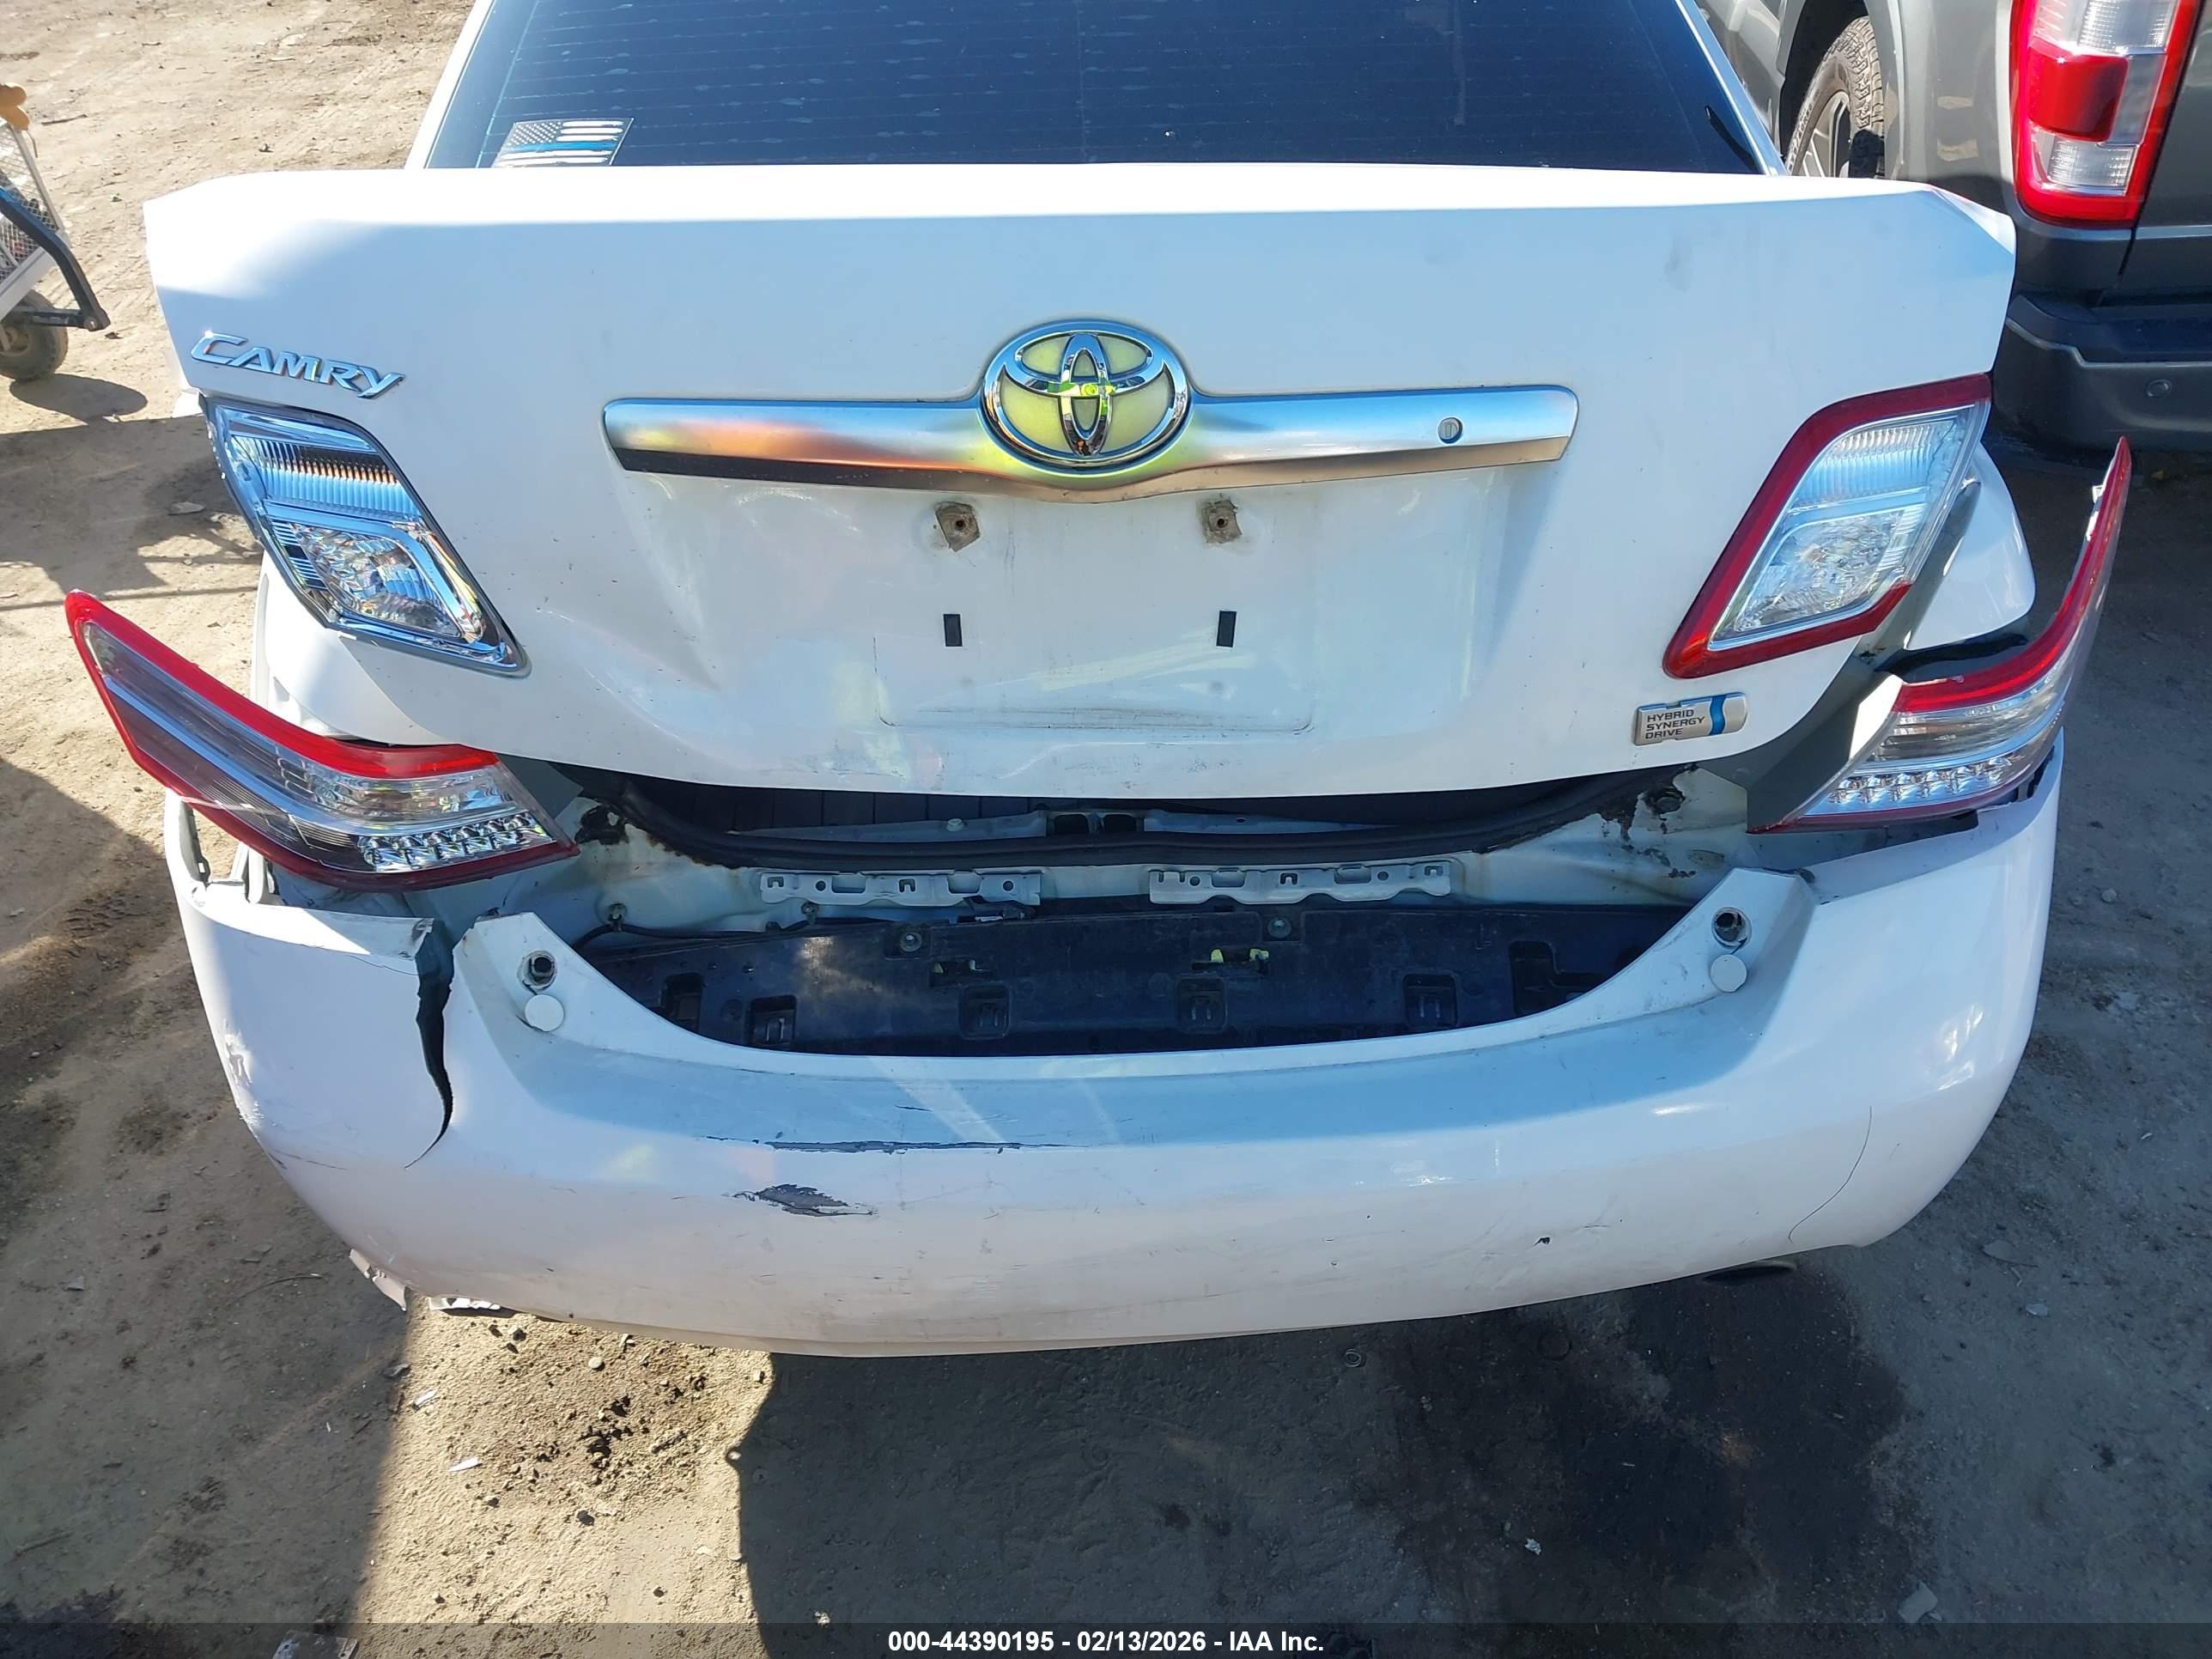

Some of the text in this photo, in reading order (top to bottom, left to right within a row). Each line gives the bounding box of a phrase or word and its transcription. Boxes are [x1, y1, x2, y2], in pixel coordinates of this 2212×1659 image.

[191, 332, 405, 398] CAMRY
[1647, 709, 1694, 722] HYBRID
[1646, 716, 1705, 731] SYNERGY
[1645, 728, 1683, 739] DRIVE
